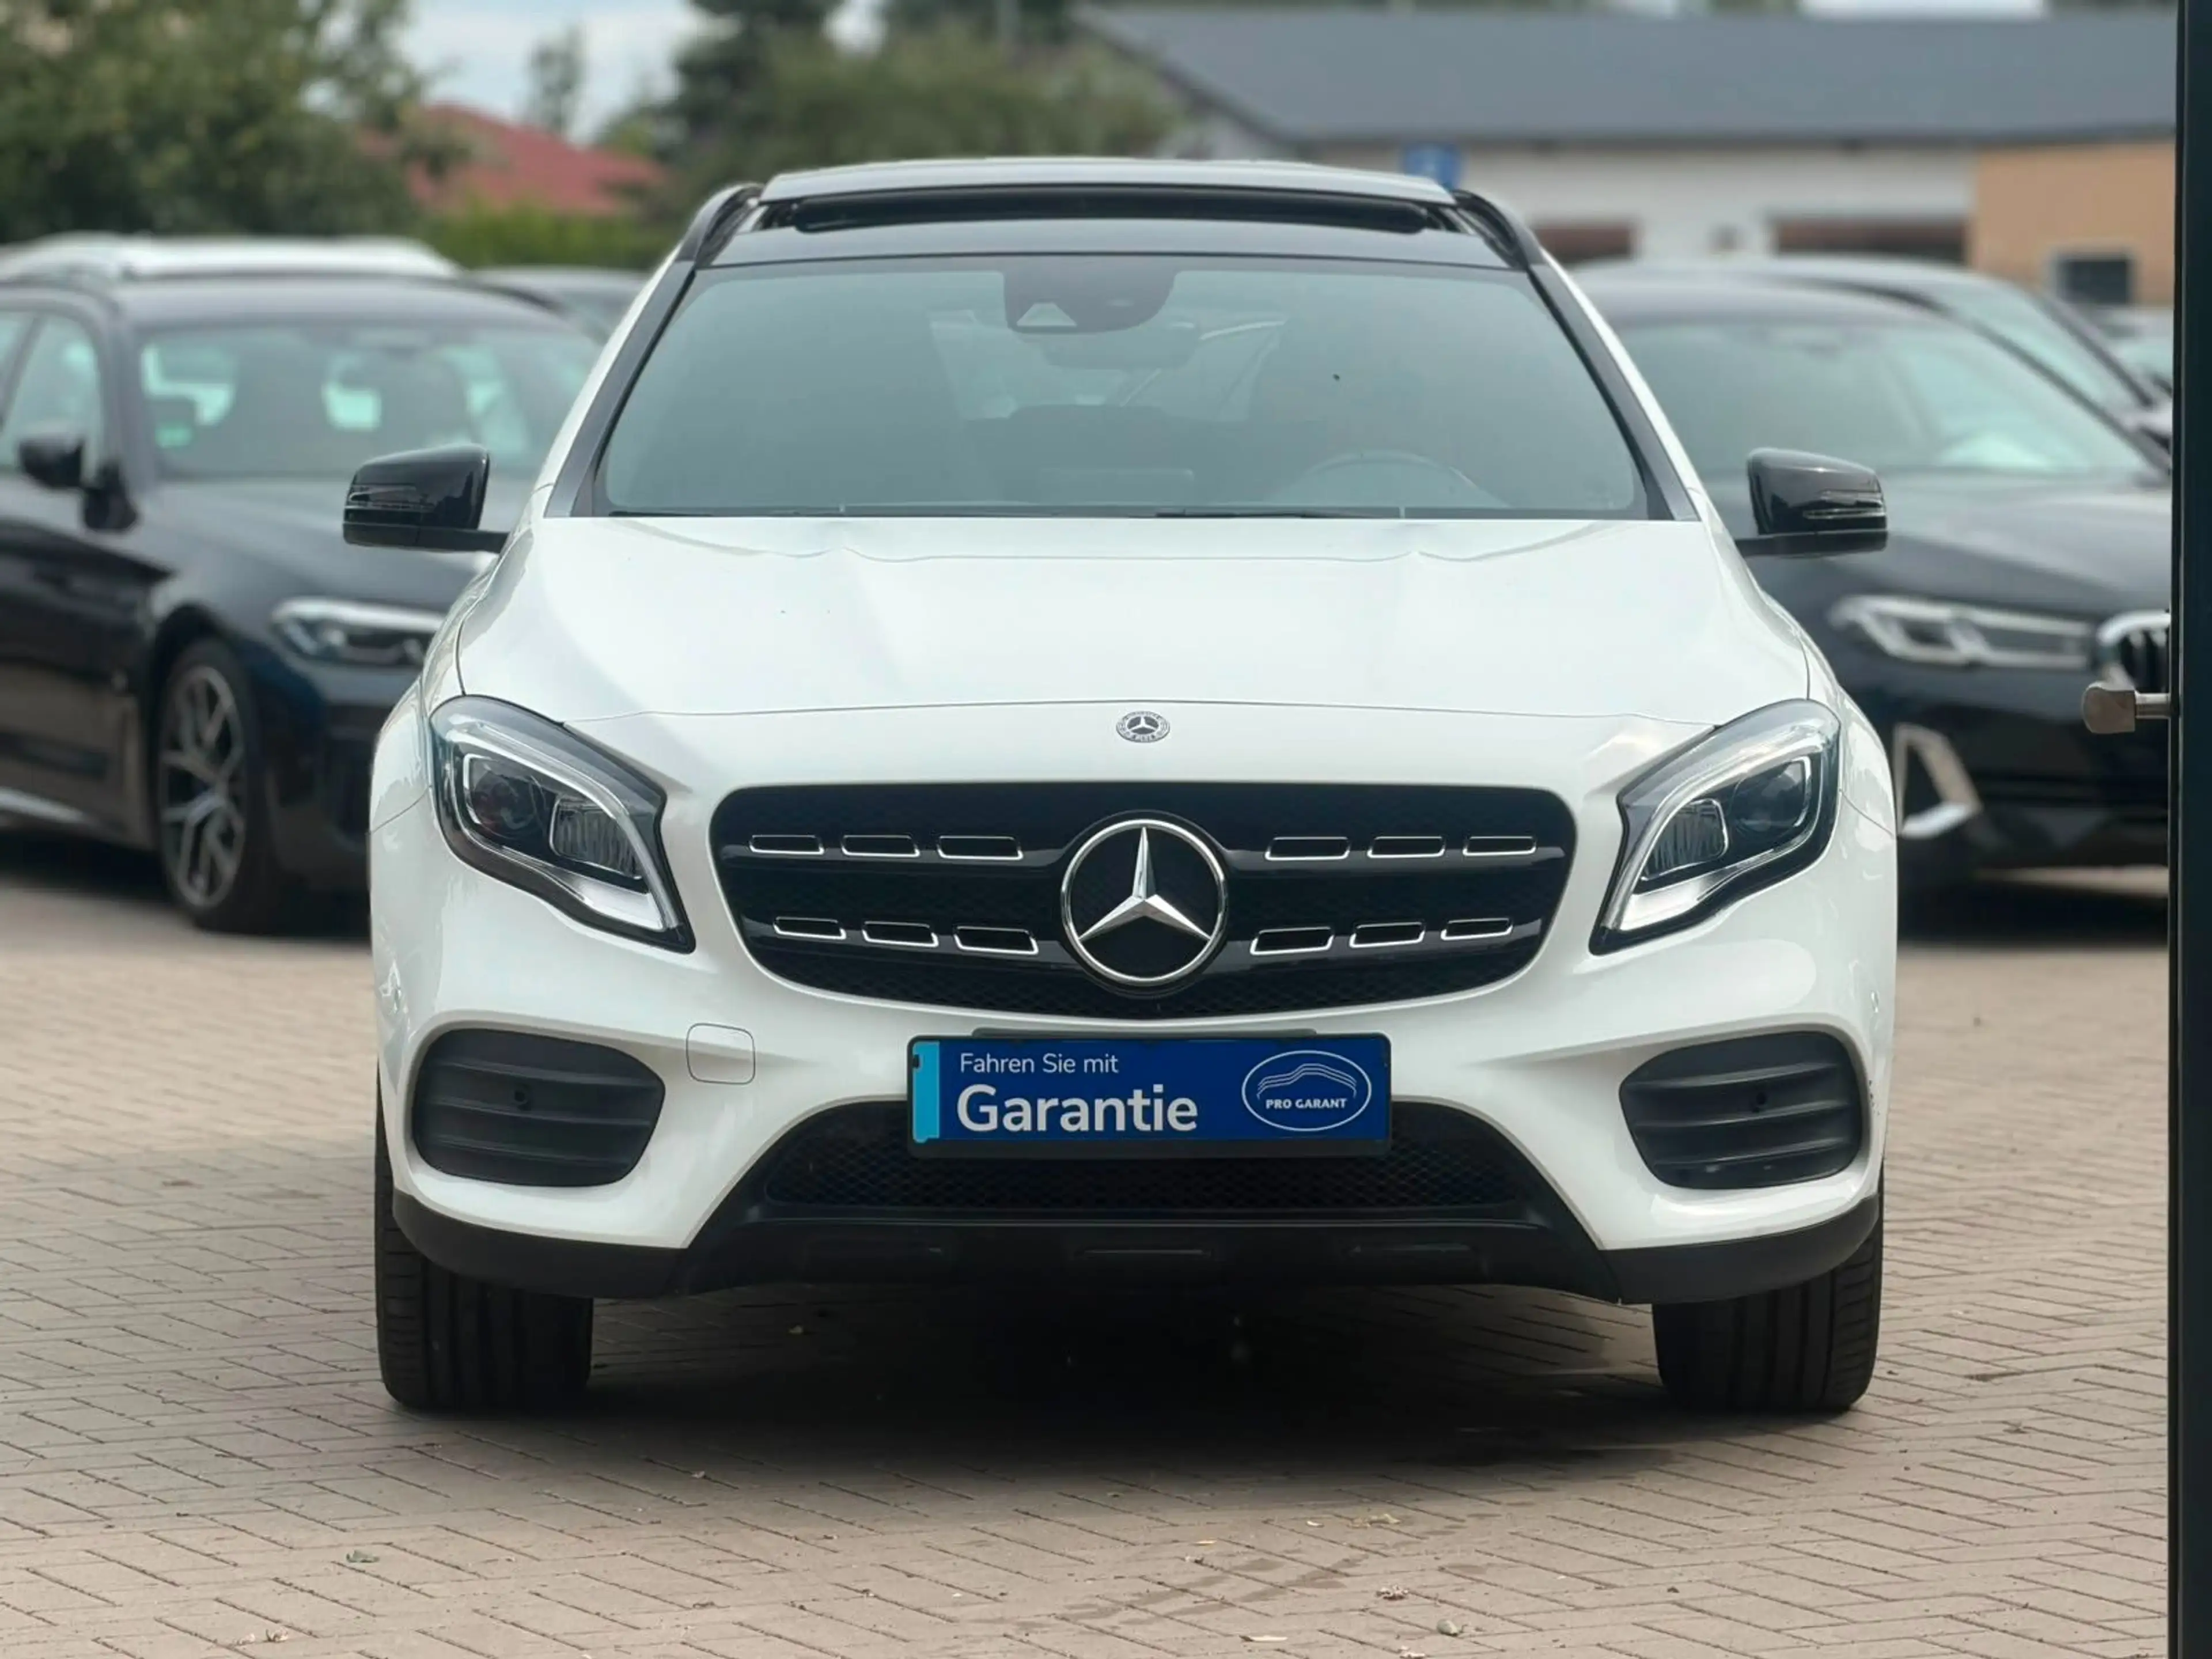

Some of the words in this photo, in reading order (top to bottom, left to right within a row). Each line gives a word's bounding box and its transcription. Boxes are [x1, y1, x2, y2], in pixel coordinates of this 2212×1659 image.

[960, 1053, 1034, 1073] Fahren
[1042, 1053, 1075, 1073] Sie
[1084, 1053, 1118, 1073] mit
[957, 1084, 1198, 1132] Garantie
[1266, 1099, 1292, 1109] PRO
[1295, 1097, 1347, 1109] GARANT
